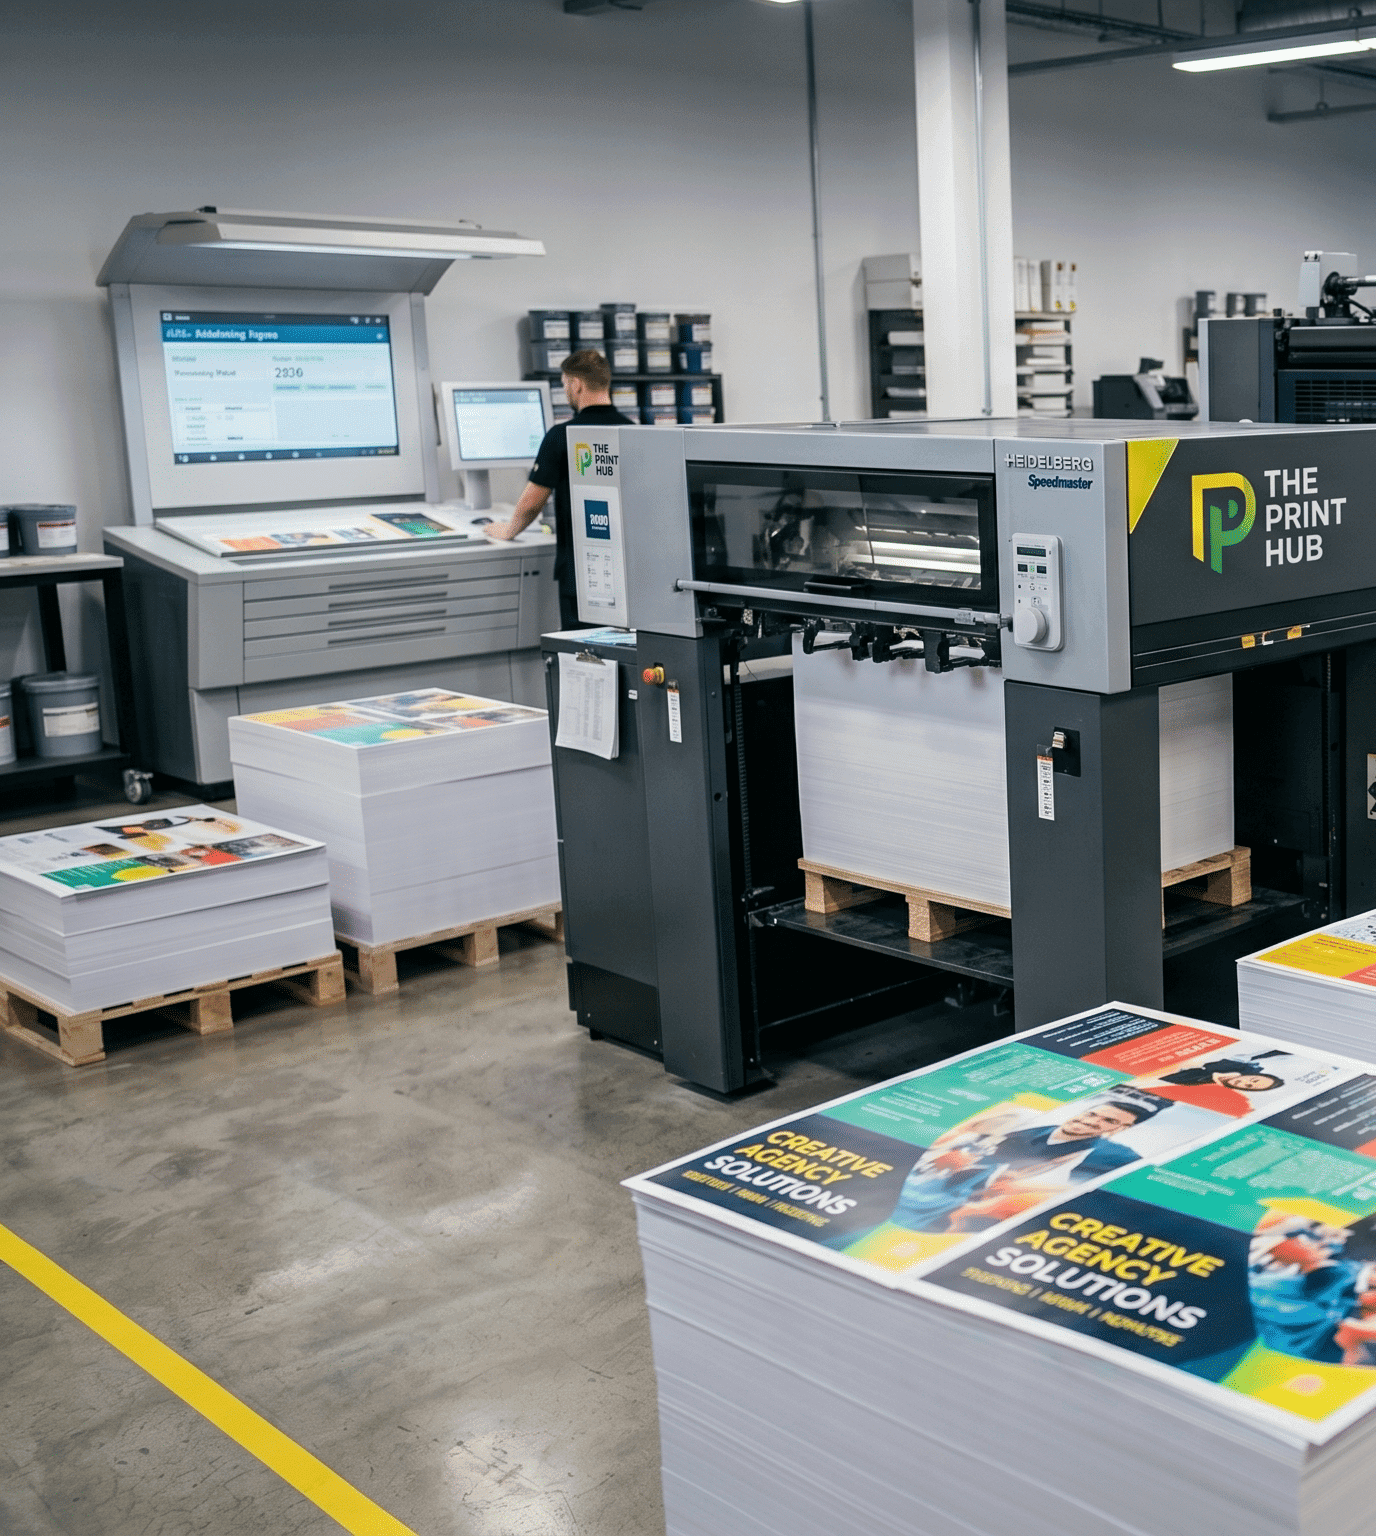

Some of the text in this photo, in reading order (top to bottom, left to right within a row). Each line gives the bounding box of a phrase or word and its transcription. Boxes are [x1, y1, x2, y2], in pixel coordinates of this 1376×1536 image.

[593, 444, 609, 453] THE
[595, 455, 619, 465] PRINT
[1004, 453, 1093, 471] HEIDELBERG
[596, 466, 613, 476] HUB
[1028, 474, 1093, 490] Speedmaster
[1264, 467, 1318, 497] THE
[1265, 498, 1346, 532] PRINT
[1265, 535, 1323, 567] HUB
[734, 1144, 852, 1186] AGENCY
[766, 1130, 894, 1179] CREATIVE
[704, 1155, 857, 1215] SOLUTIONS
[1014, 1229, 1178, 1287] AGENCY
[1049, 1212, 1226, 1278] CREATIVE
[985, 1246, 1207, 1329] SOLUTIONS
